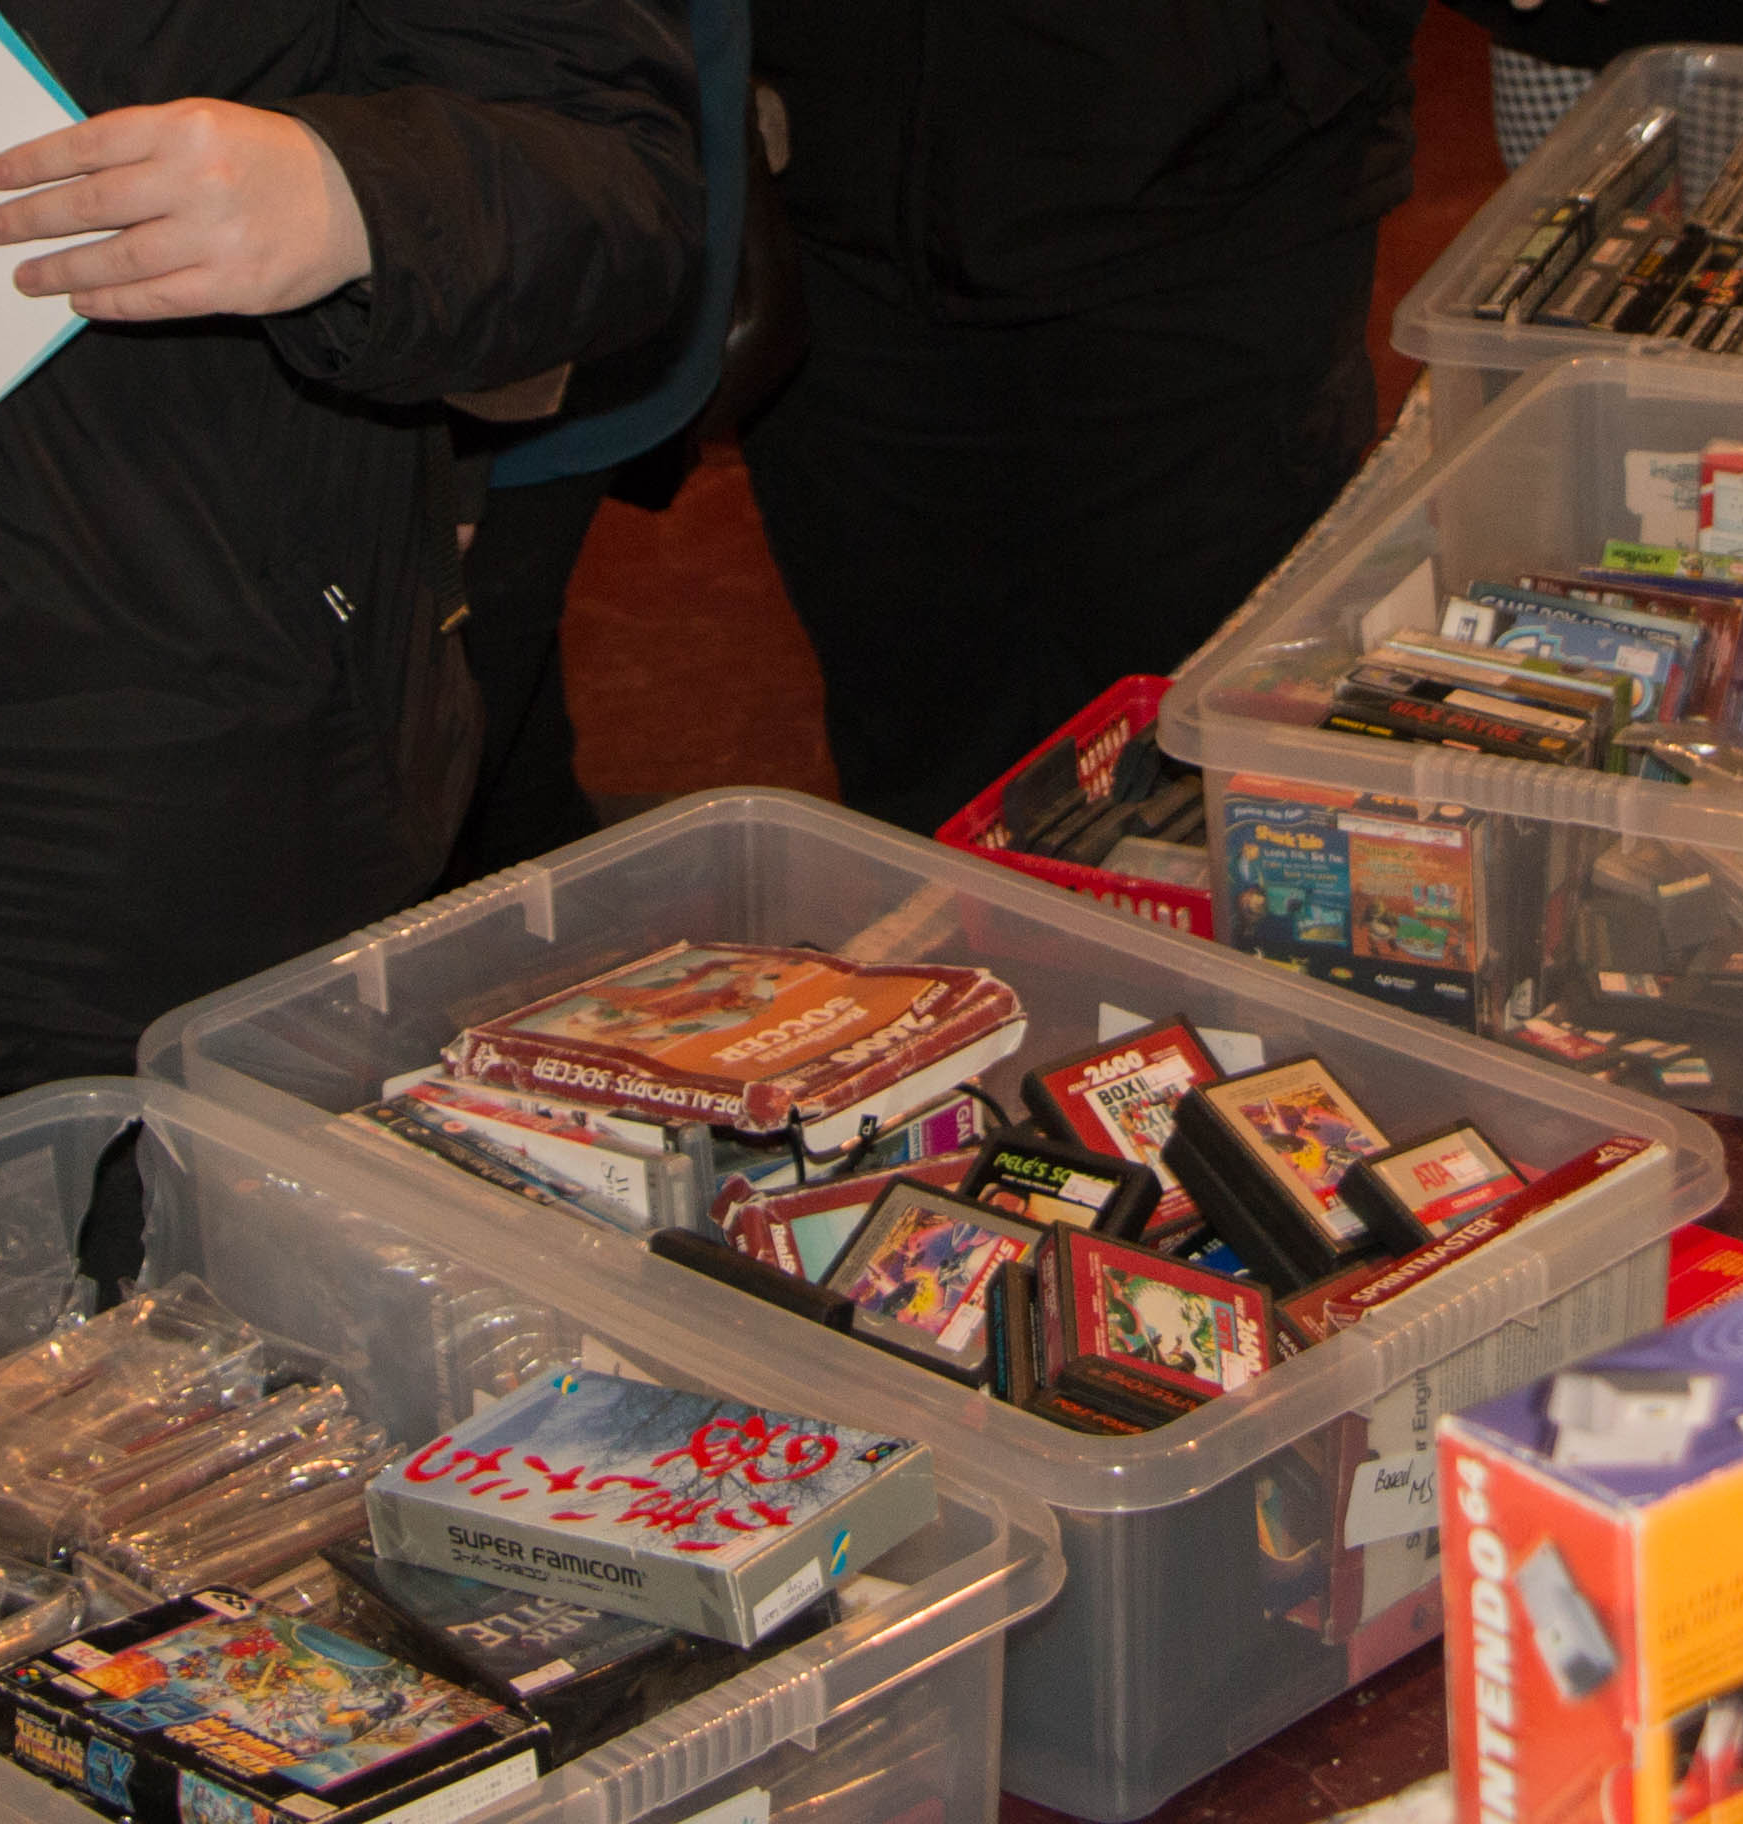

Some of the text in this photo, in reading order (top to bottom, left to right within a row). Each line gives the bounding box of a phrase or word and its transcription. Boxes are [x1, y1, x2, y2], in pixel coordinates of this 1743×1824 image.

[1388, 699, 1527, 744] MAX PAYNE
[531, 1056, 610, 1093] SOCCER
[1082, 1048, 1147, 1087] 2600
[1411, 1158, 1459, 1191] ATA
[1350, 1215, 1501, 1304] SPRINTMASTER
[447, 1525, 526, 1562] SUPER
[1468, 1528, 1519, 1824] INTENDO
